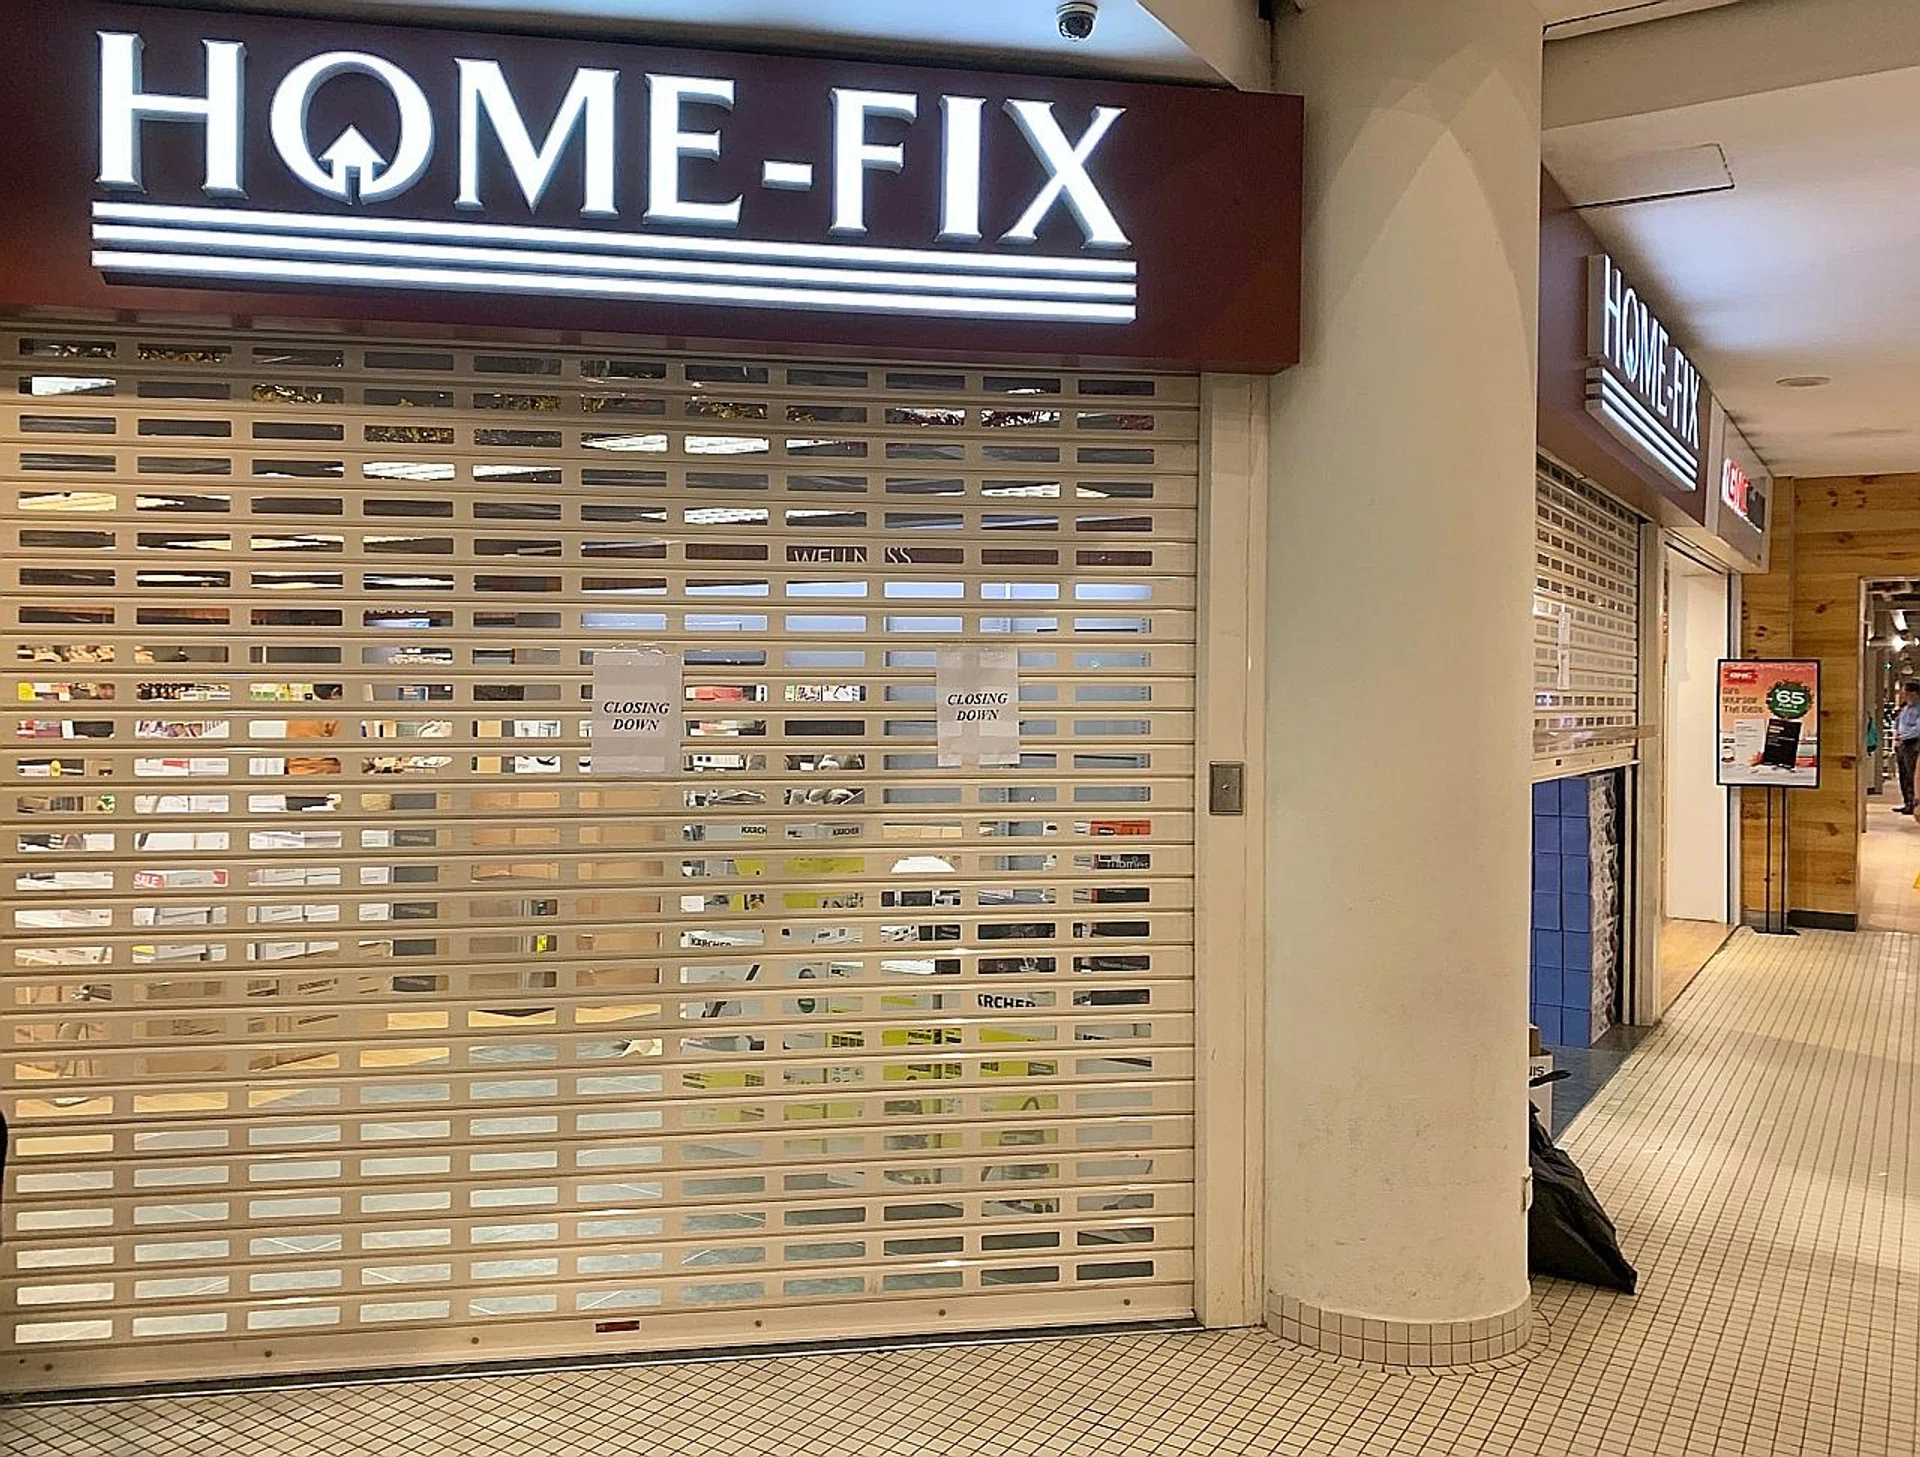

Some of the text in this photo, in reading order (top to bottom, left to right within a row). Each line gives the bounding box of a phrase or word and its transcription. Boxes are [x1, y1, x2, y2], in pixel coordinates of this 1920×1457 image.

[95, 31, 1131, 249] HOME-FIX
[1603, 254, 1700, 450] HOME-FIX
[945, 693, 1008, 705] CLOSING
[603, 701, 670, 714] CLOSING
[957, 709, 999, 721] DOWN
[613, 719, 659, 730] DOWN
[134, 874, 158, 886] SALE
